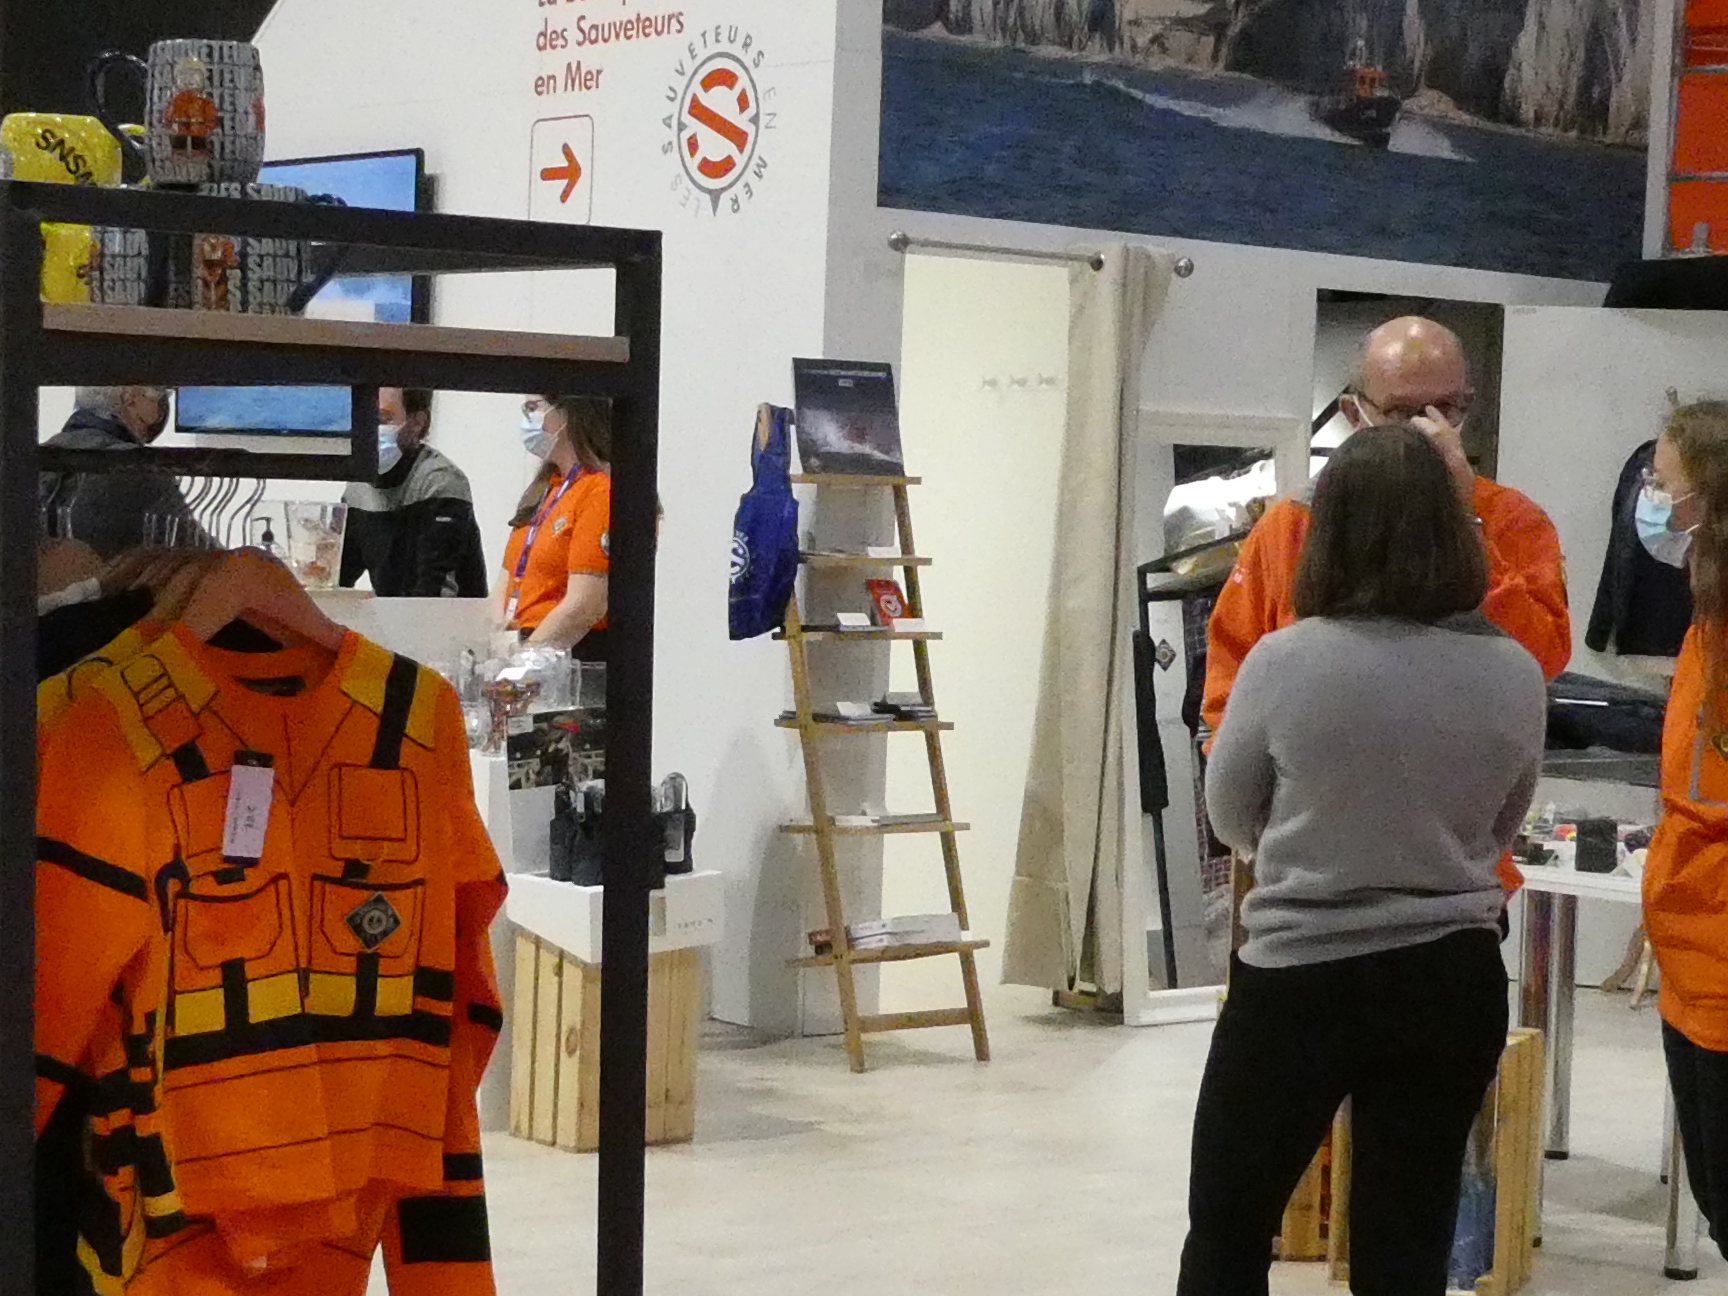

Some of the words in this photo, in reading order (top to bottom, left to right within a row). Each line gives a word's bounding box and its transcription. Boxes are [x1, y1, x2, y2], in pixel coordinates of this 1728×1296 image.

[536, 17, 568, 52] des
[575, 11, 684, 47] Sauveteurs
[534, 73, 557, 96] en
[564, 59, 604, 92] Mer
[661, 24, 766, 156] SAUVETEURS
[763, 86, 778, 130] EN
[729, 154, 768, 214] MER
